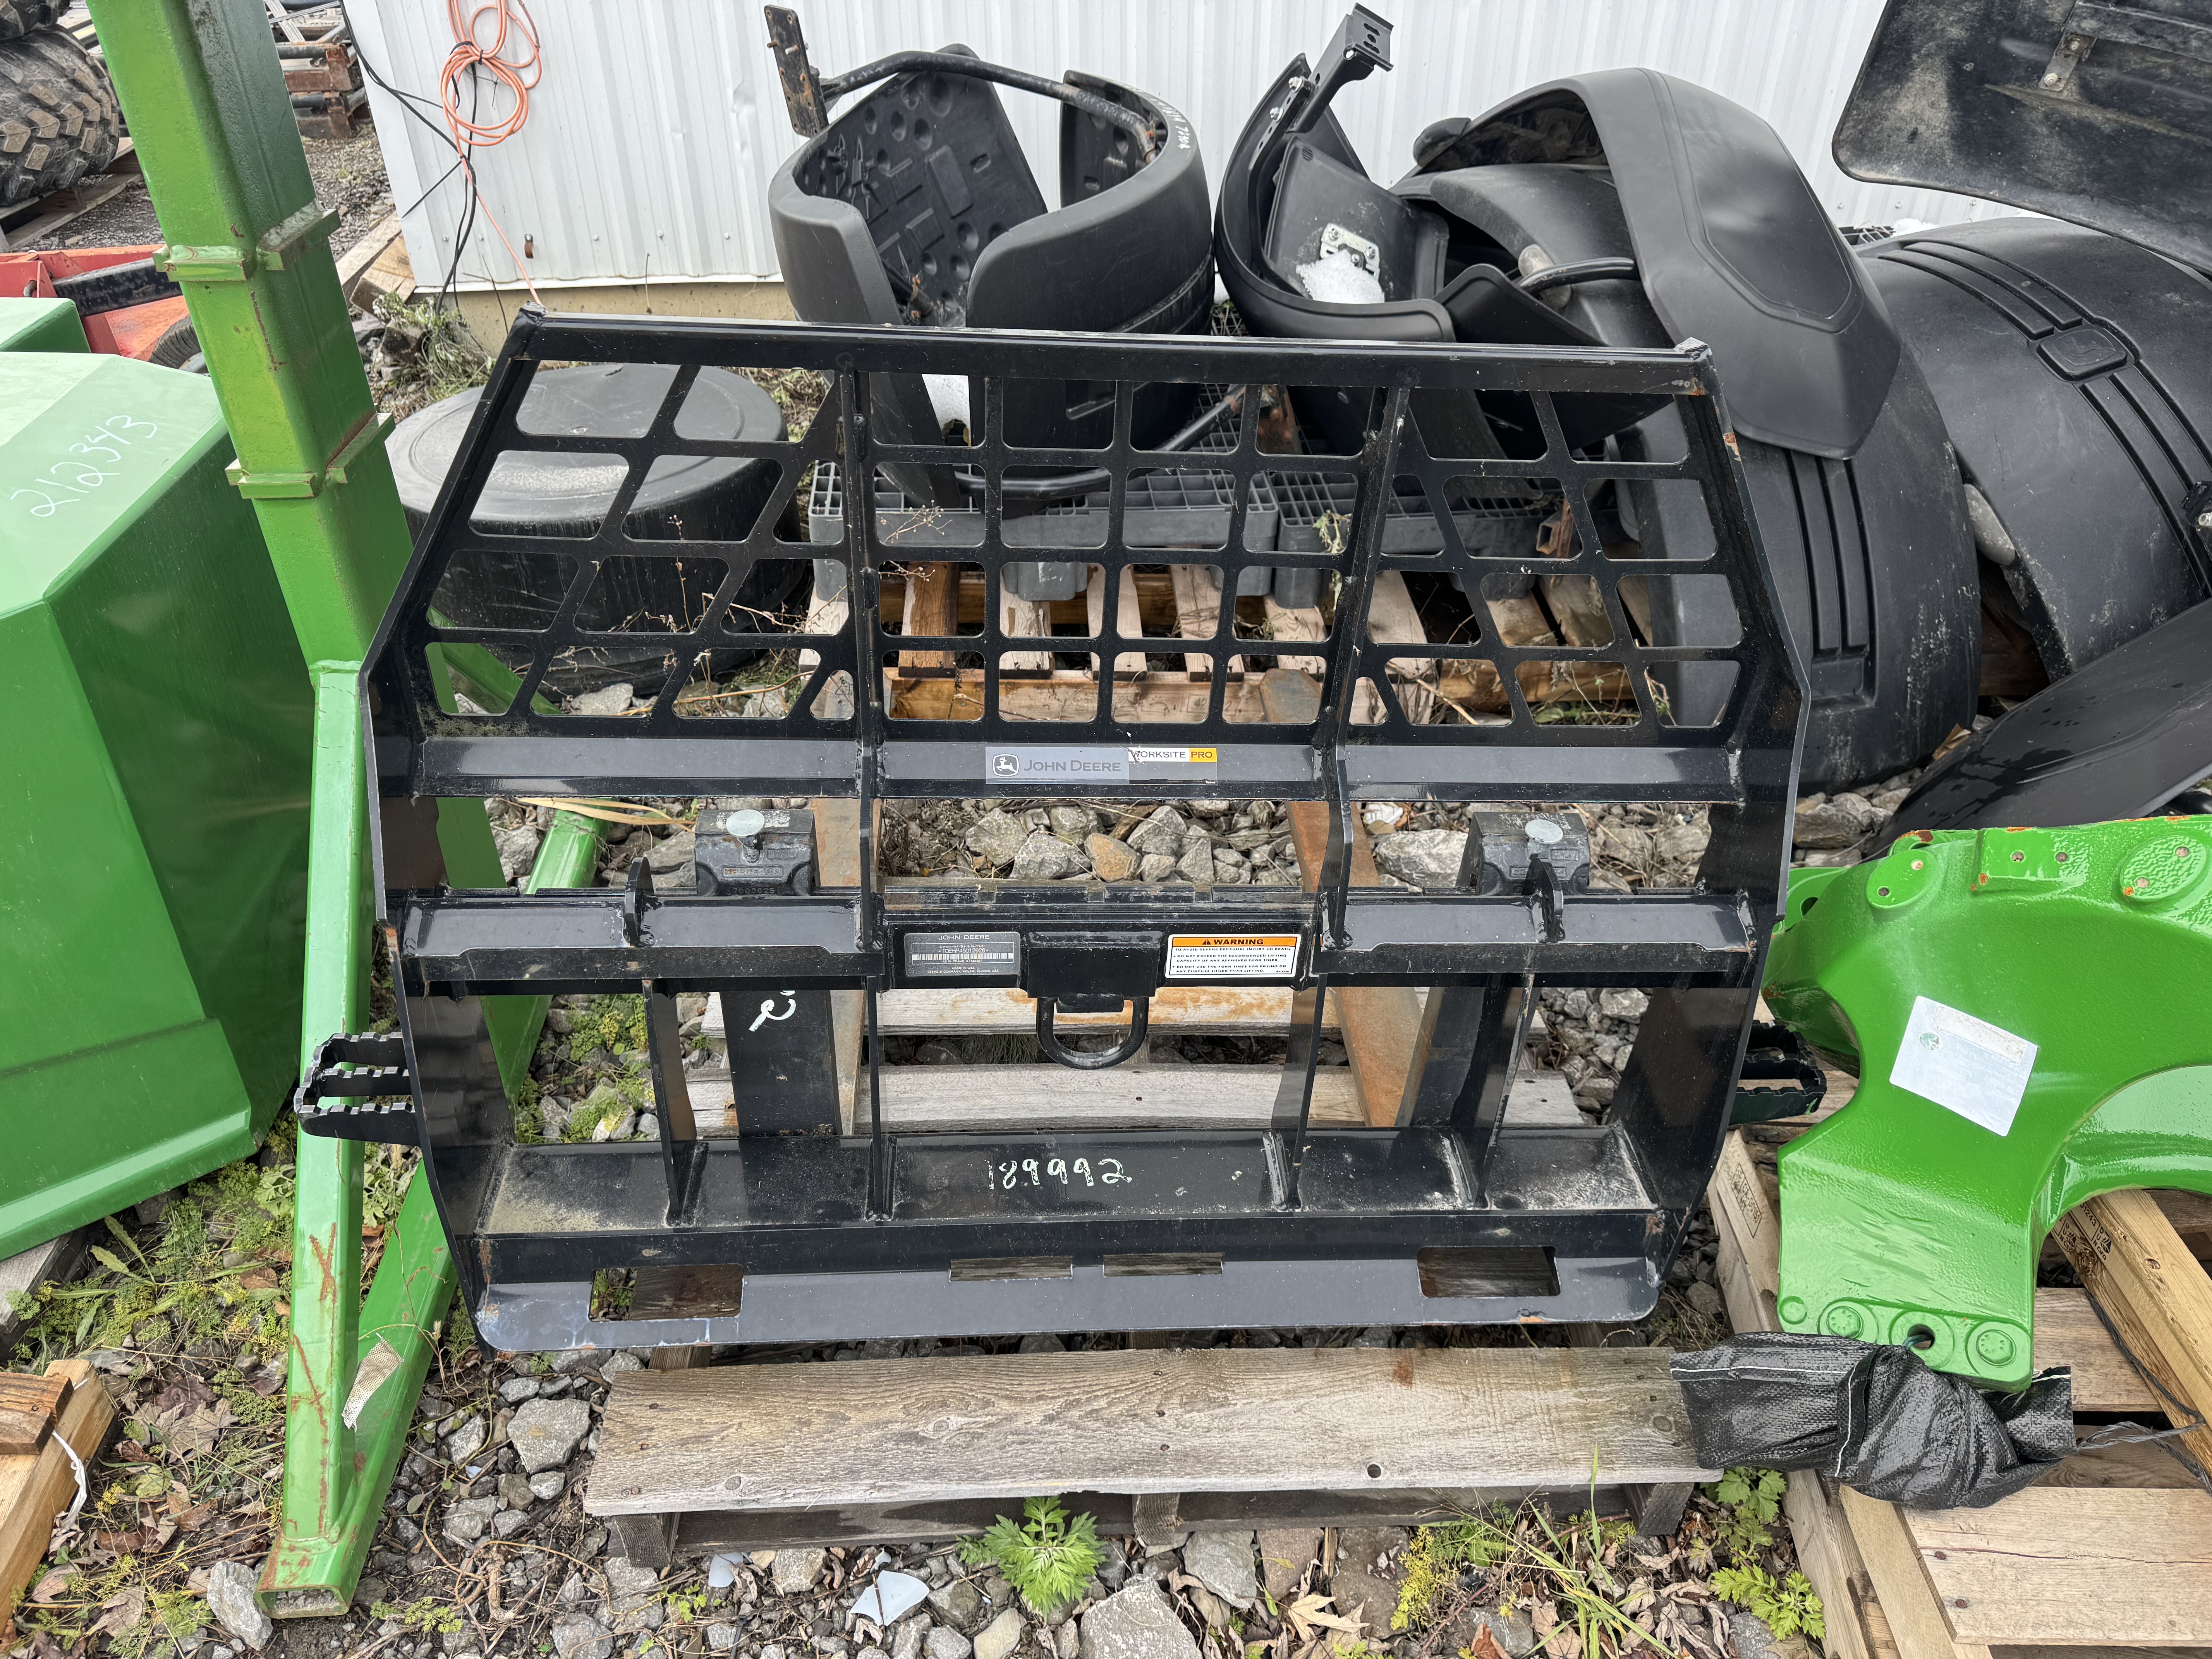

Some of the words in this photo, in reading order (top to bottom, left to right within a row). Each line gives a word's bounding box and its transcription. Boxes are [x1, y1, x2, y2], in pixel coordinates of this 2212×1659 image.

[1024, 759, 1066, 771] JOHN
[1070, 760, 1121, 771] DEERE
[984, 1158, 1133, 1190] 189992
